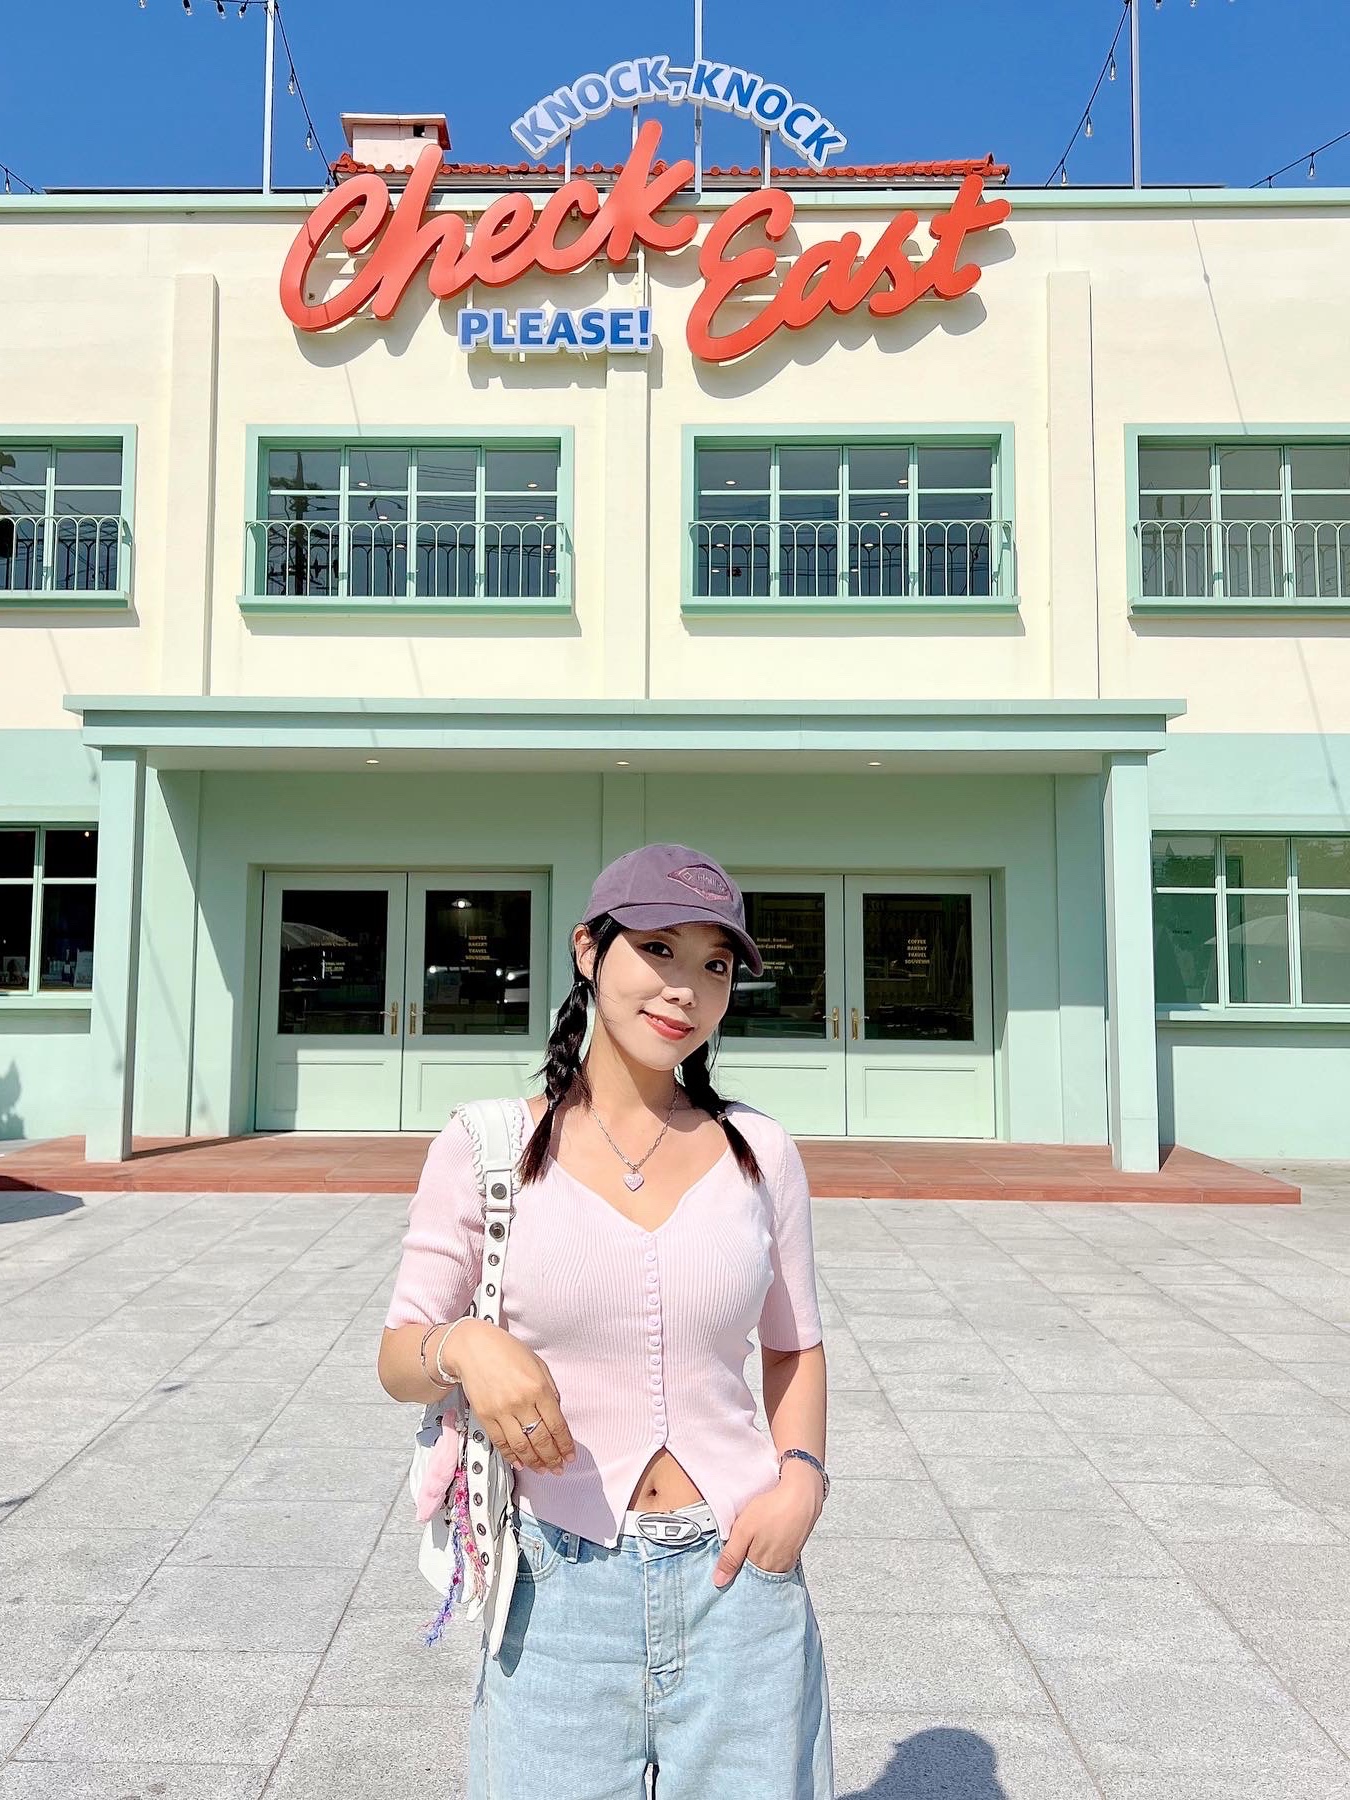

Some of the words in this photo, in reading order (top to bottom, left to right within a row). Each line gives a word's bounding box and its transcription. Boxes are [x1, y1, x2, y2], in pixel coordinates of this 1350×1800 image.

[515, 60, 685, 151] KNOCK,
[690, 62, 842, 163] KNOCK
[280, 120, 697, 332] Check
[686, 174, 1011, 363] East
[460, 309, 650, 347] PLEASE!
